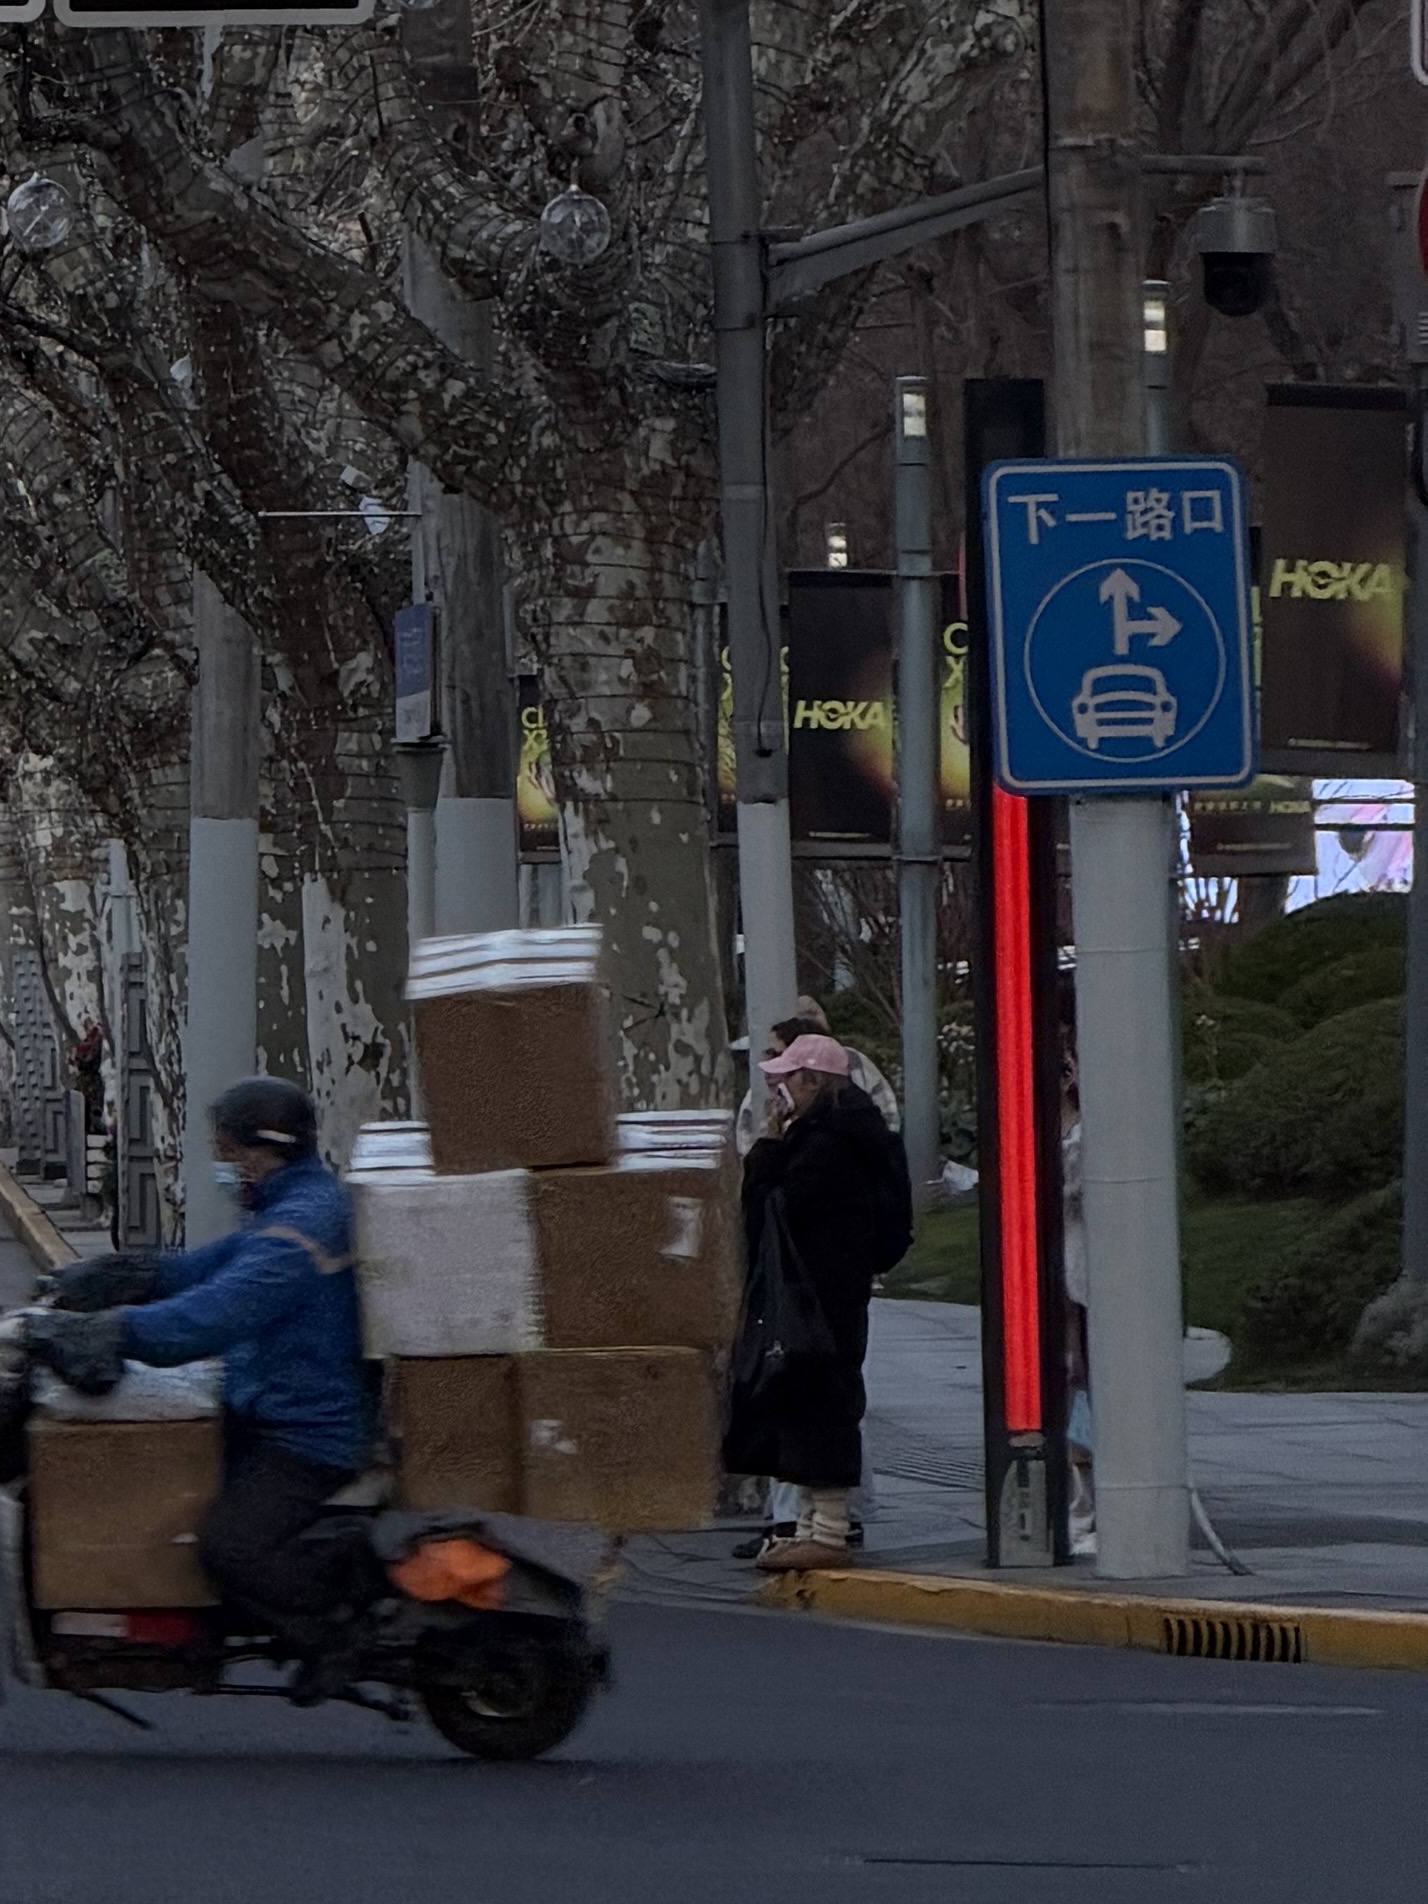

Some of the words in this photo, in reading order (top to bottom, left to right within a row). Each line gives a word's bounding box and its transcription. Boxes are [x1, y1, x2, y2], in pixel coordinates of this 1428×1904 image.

[1006, 488, 1223, 545] 下一路口
[1269, 558, 1394, 601] HOKA
[794, 699, 887, 730] HOKA
